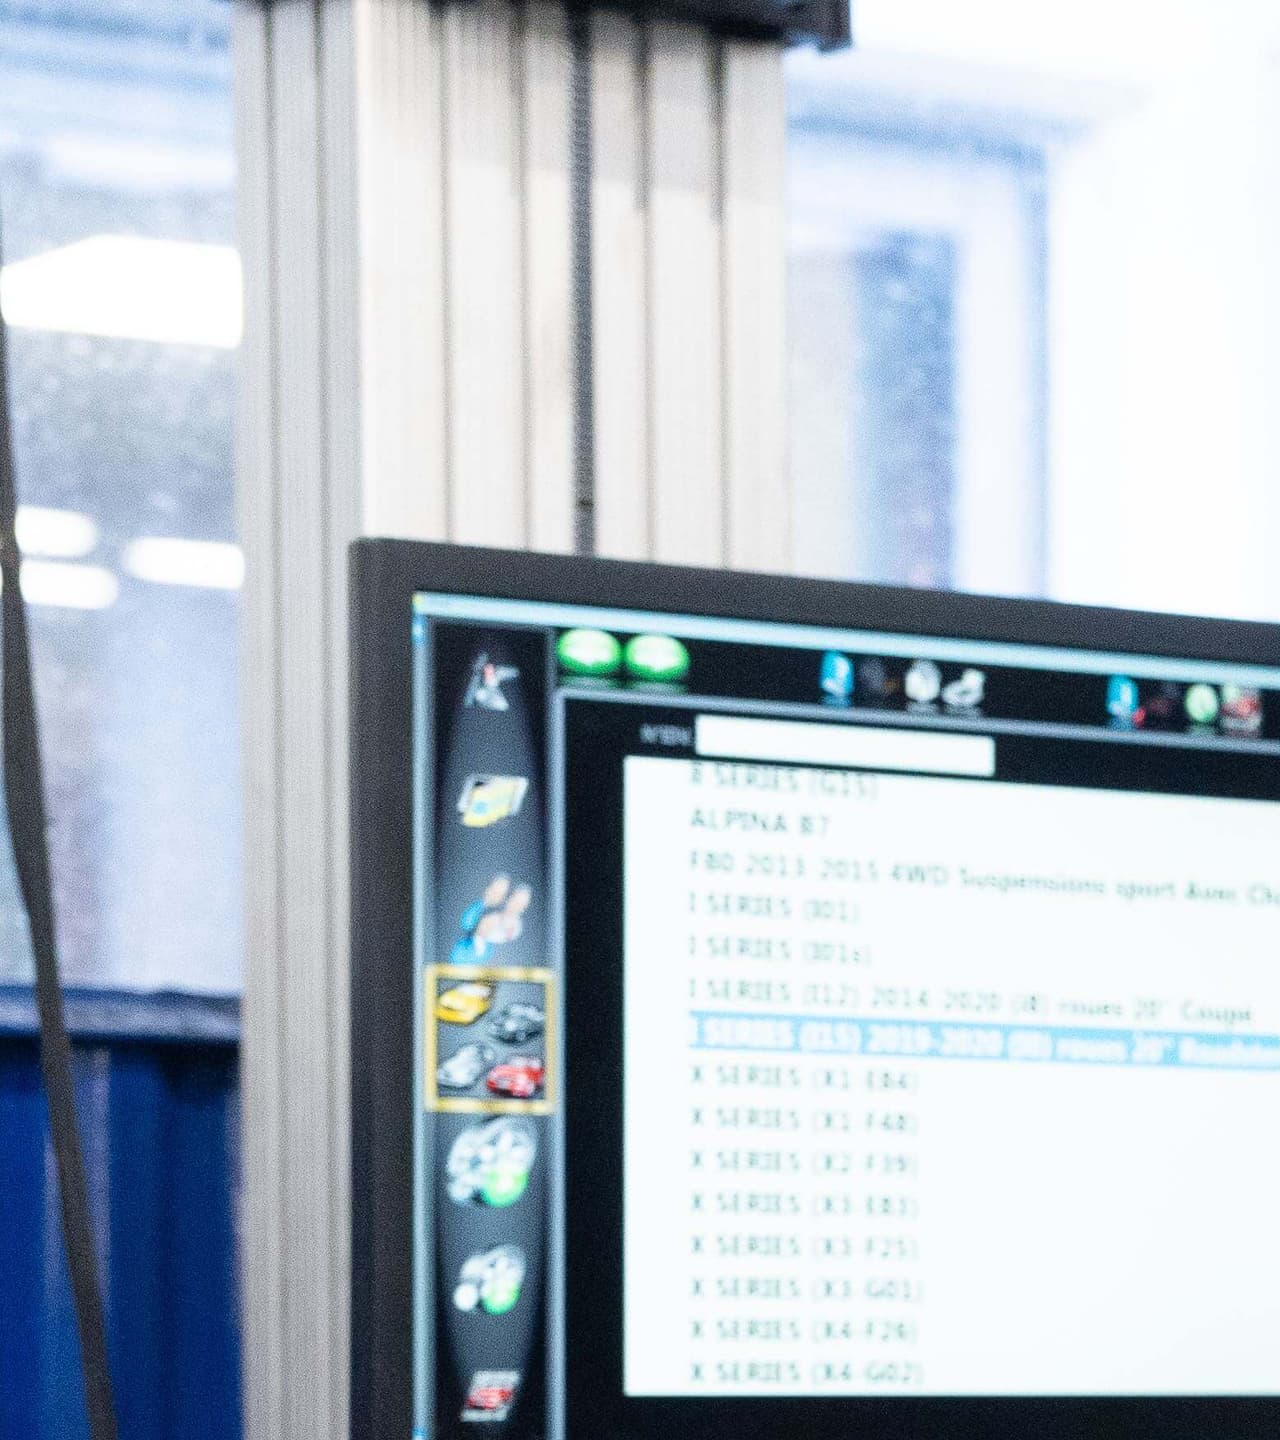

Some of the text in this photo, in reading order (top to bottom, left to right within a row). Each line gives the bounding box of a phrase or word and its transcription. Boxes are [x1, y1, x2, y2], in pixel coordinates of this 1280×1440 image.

[713, 766, 800, 793] SERIES
[688, 806, 790, 834] ALPINA
[704, 890, 793, 920] SERIES
[704, 933, 792, 963] SERIES
[706, 978, 792, 1004] SERIES
[715, 1062, 802, 1090] SERIES
[714, 1104, 802, 1132] SERIES
[714, 1147, 802, 1176] SERIES
[714, 1190, 802, 1216] SERIES
[715, 1233, 802, 1260] SERIES
[713, 1274, 803, 1302] SERIES
[714, 1316, 802, 1343] SERIES
[714, 1359, 802, 1387] SERIES
